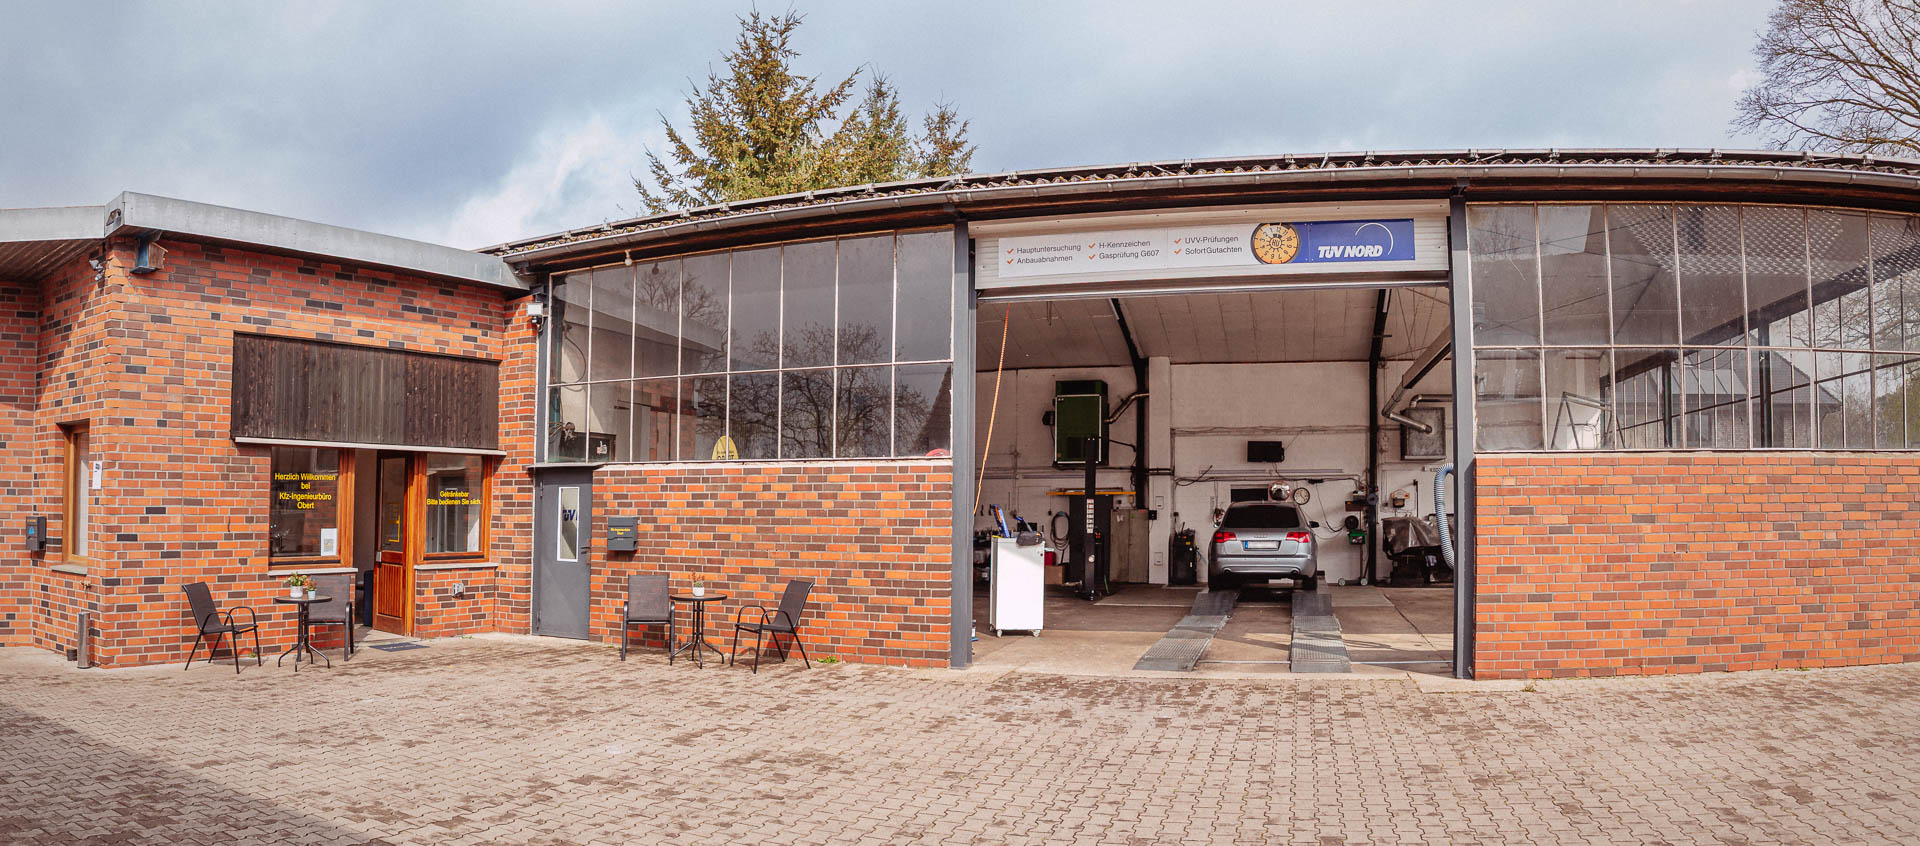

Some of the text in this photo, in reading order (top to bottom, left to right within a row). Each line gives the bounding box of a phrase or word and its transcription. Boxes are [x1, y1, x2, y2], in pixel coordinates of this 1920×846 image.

[1099, 240, 1150, 248] H-Kennzeichen
[1185, 236, 1238, 244] UVV-Prüfungen
[1017, 244, 1082, 255] Hauptuntersuchung
[1318, 245, 1383, 258] TÜV NORD
[1017, 255, 1073, 265] Anbauabnahmen
[1099, 252, 1138, 260] Gasprüfung
[280, 492, 332, 501] Kfz-Ingenieurbüro
